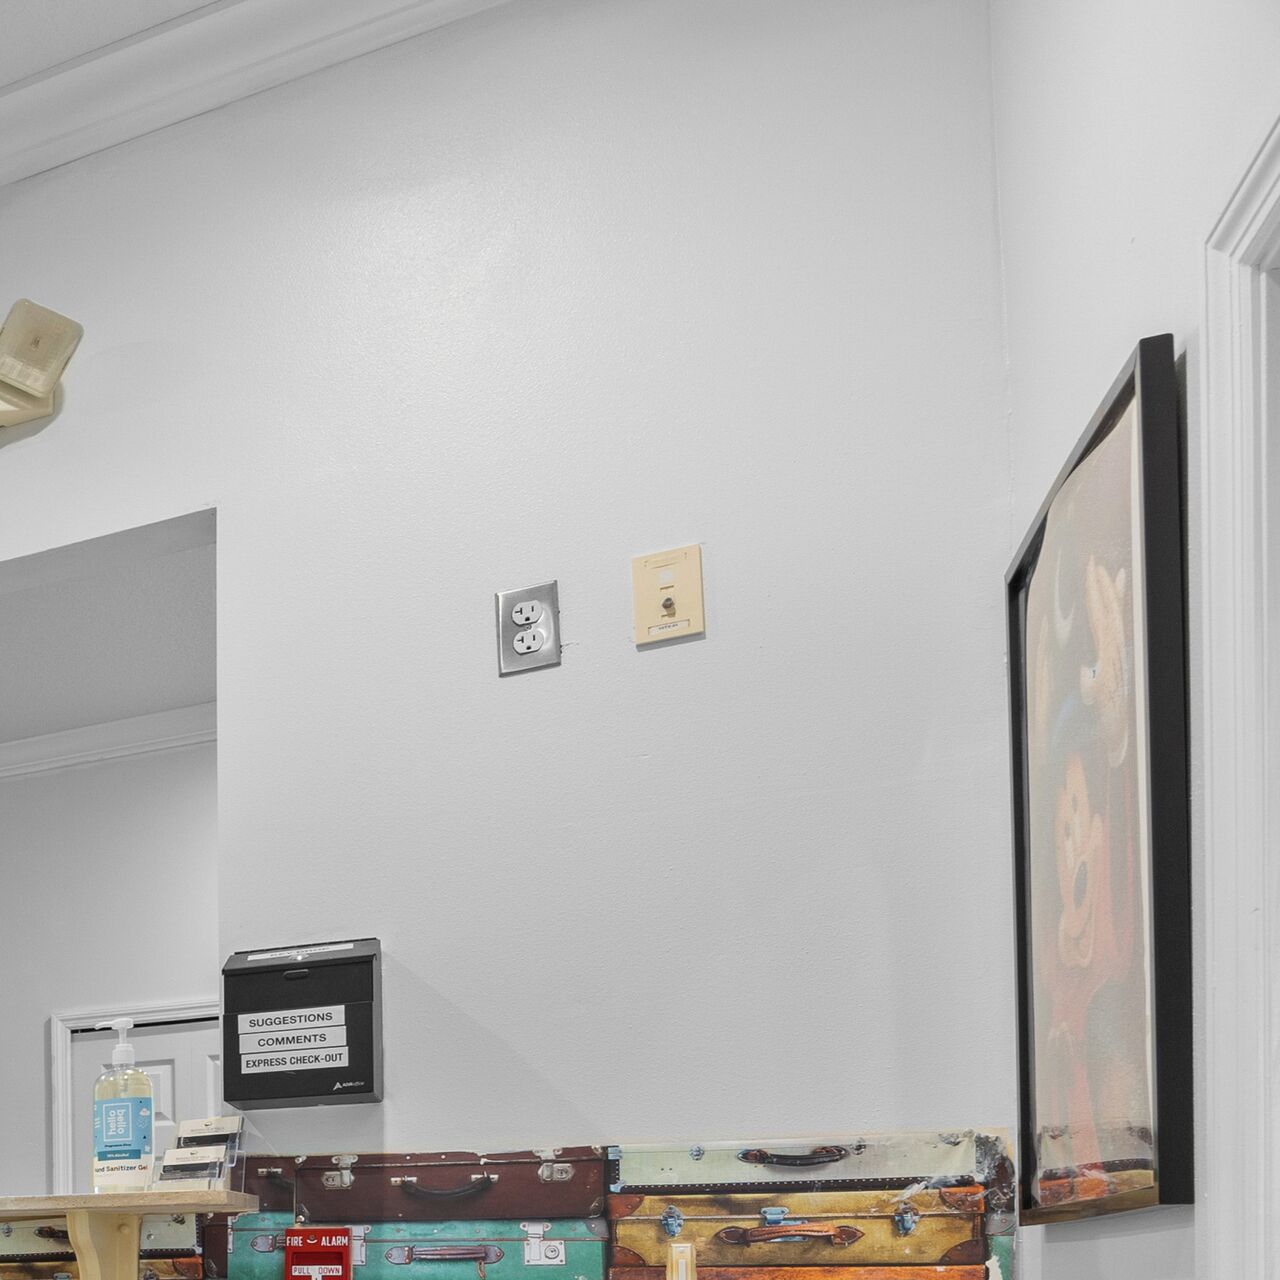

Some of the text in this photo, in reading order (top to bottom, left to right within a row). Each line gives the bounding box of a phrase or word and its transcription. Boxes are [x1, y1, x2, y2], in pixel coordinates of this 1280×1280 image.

[248, 1012, 333, 1028] SUGGESTIONS
[257, 1033, 327, 1047] COMMENTS
[245, 1052, 344, 1069] EXPRESS CHECK-OUT
[106, 1164, 137, 1172] Sanitizer
[286, 1236, 349, 1247] FIRE ALARM
[293, 1266, 341, 1275] PULL DOWN
